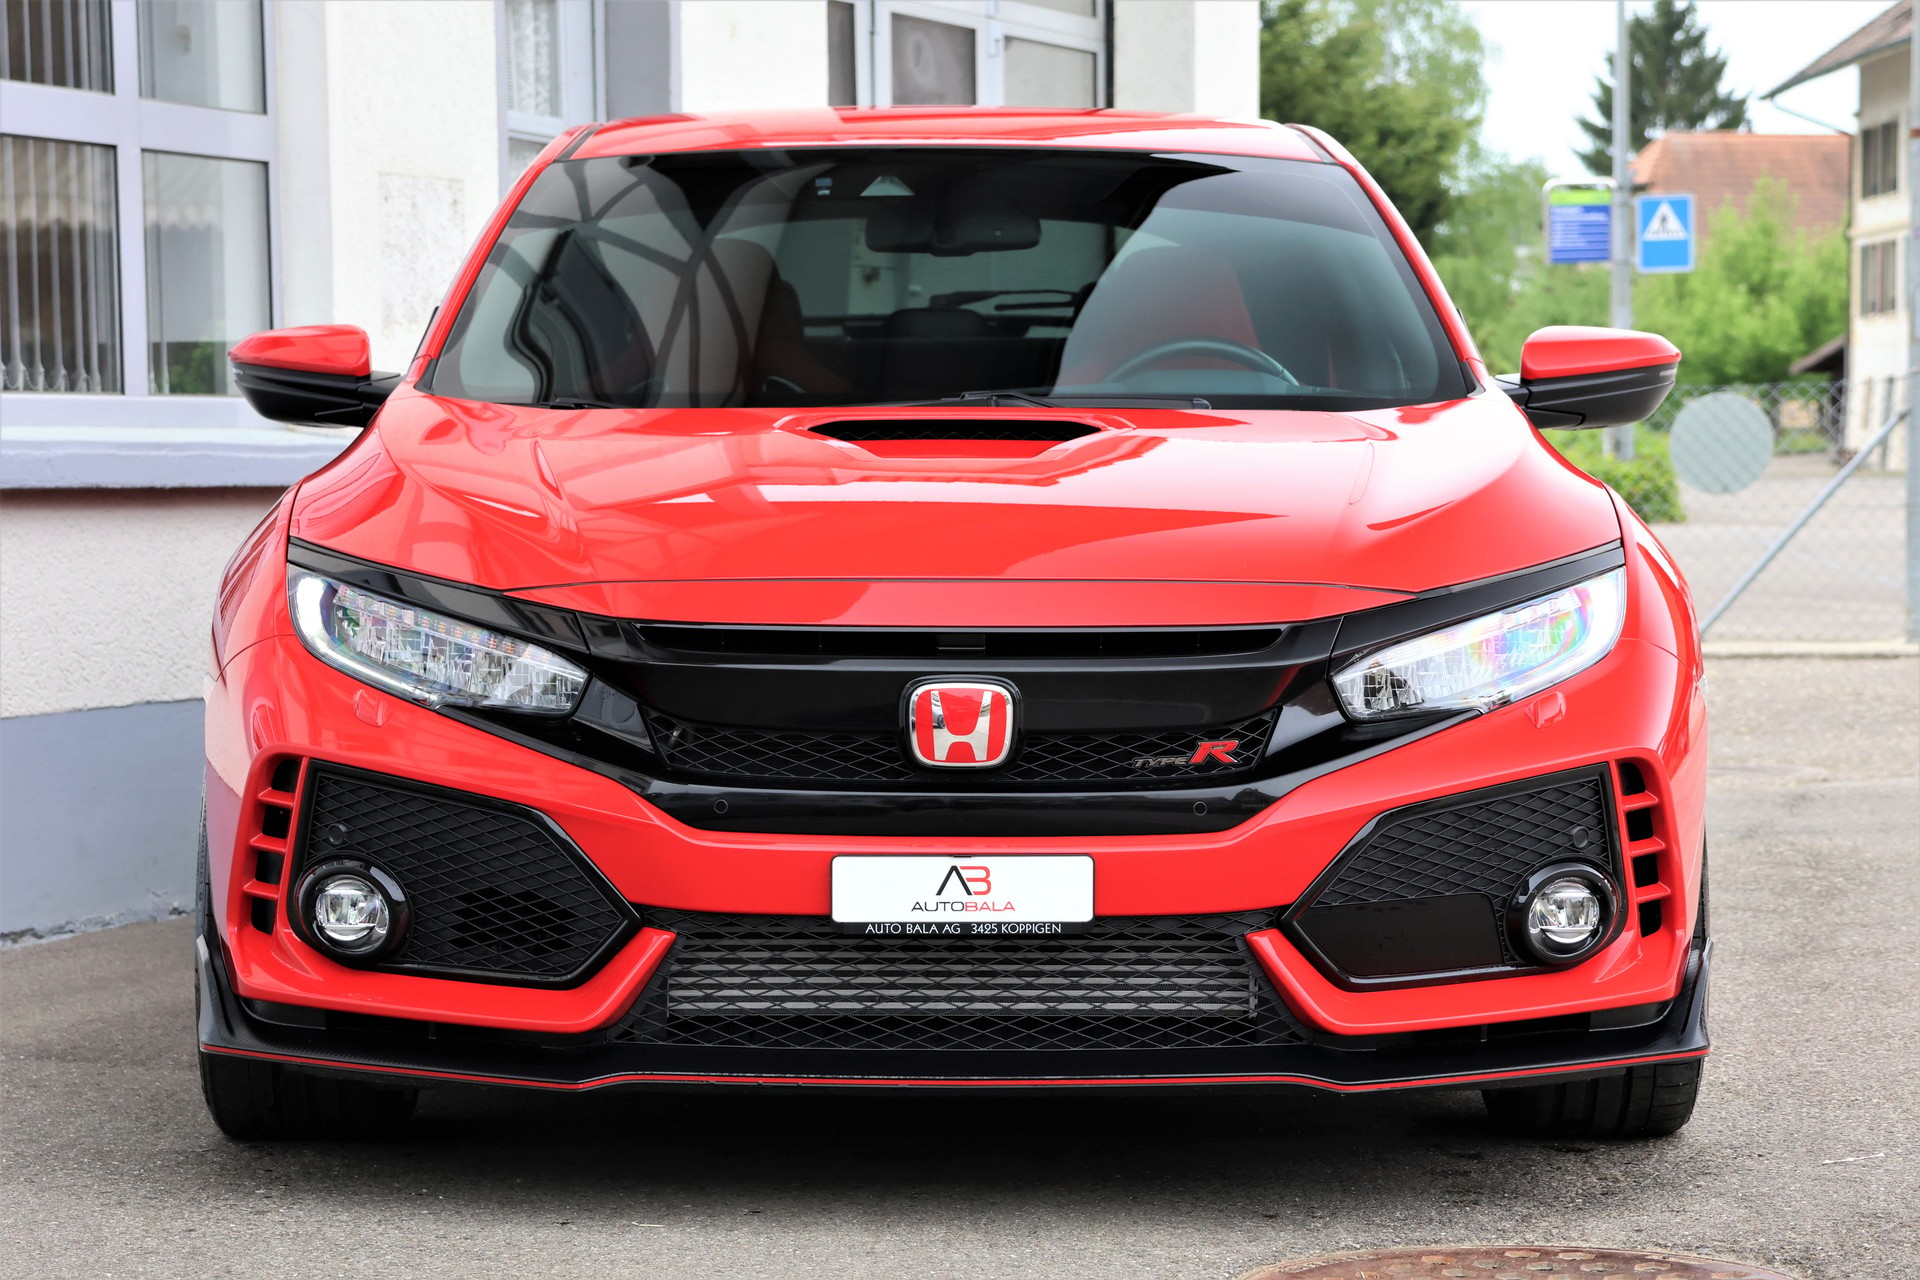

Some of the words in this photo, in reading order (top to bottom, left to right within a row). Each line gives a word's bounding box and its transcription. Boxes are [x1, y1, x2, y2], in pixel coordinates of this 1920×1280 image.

[930, 690, 993, 761] H
[1133, 757, 1188, 768] TYPE
[1188, 739, 1240, 764] R
[935, 865, 992, 896] AB
[911, 901, 1016, 912] AUTOBALA
[865, 923, 902, 934] AUTO
[906, 923, 939, 934] BALA
[941, 923, 961, 934] AG
[970, 923, 998, 934] 3425
[1001, 923, 1062, 934] KOPPIGEN
